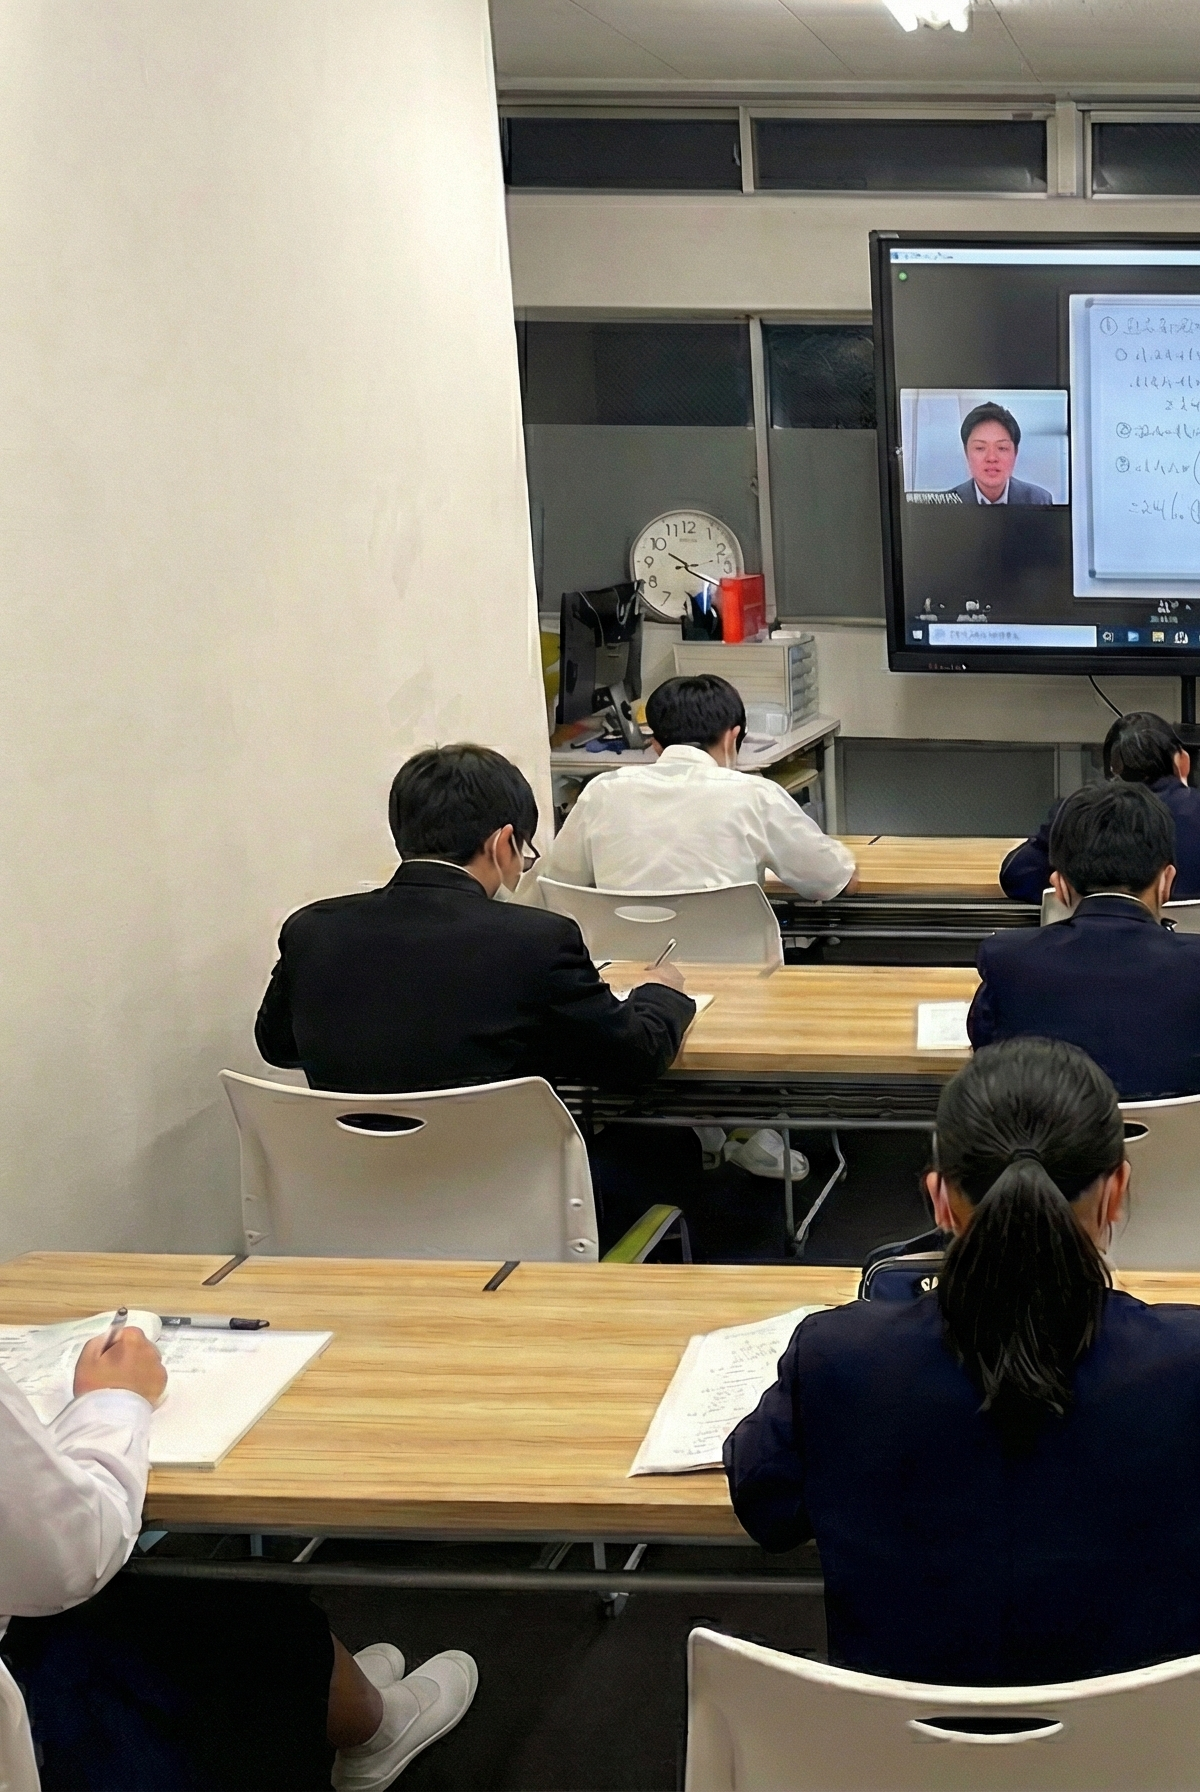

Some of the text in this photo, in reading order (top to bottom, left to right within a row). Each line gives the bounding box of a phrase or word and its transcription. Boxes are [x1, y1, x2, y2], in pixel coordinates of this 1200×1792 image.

[666, 523, 678, 537] 11
[682, 520, 696, 534] 12
[707, 527, 712, 540] 1
[650, 537, 667, 551] 10
[644, 555, 654, 568] 9
[648, 575, 658, 588] 8
[661, 590, 671, 607] 7
